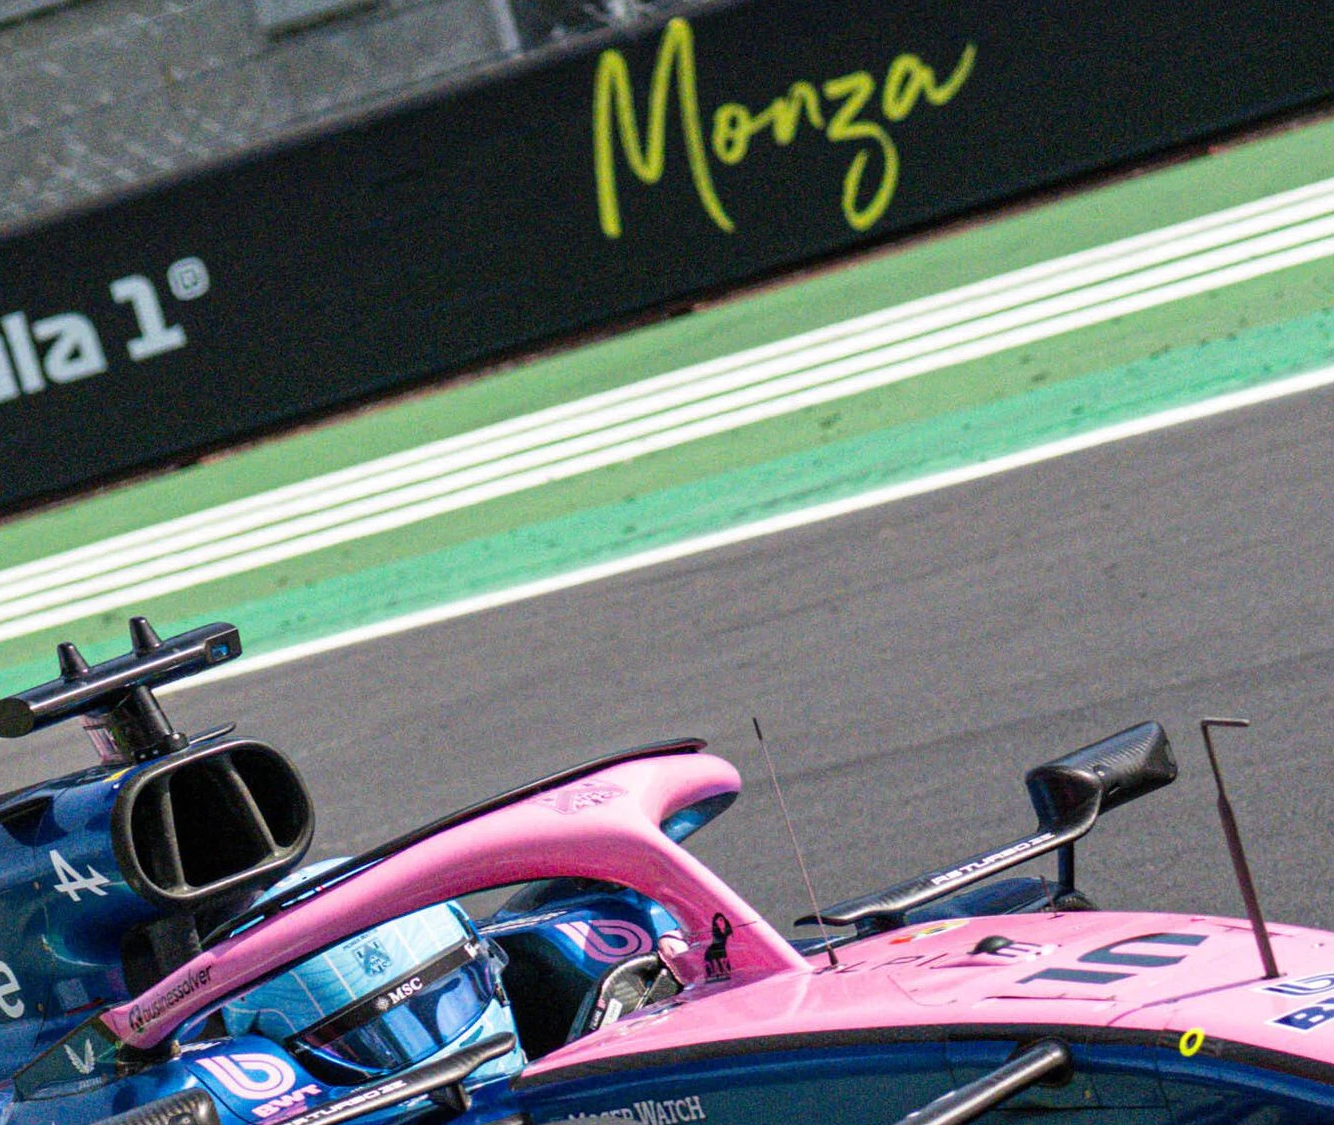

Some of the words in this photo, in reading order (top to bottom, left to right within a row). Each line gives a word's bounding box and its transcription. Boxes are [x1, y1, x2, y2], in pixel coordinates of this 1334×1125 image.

[593, 17, 977, 238] Monza
[386, 976, 423, 1005] MSC
[251, 1084, 323, 1119] BWT
